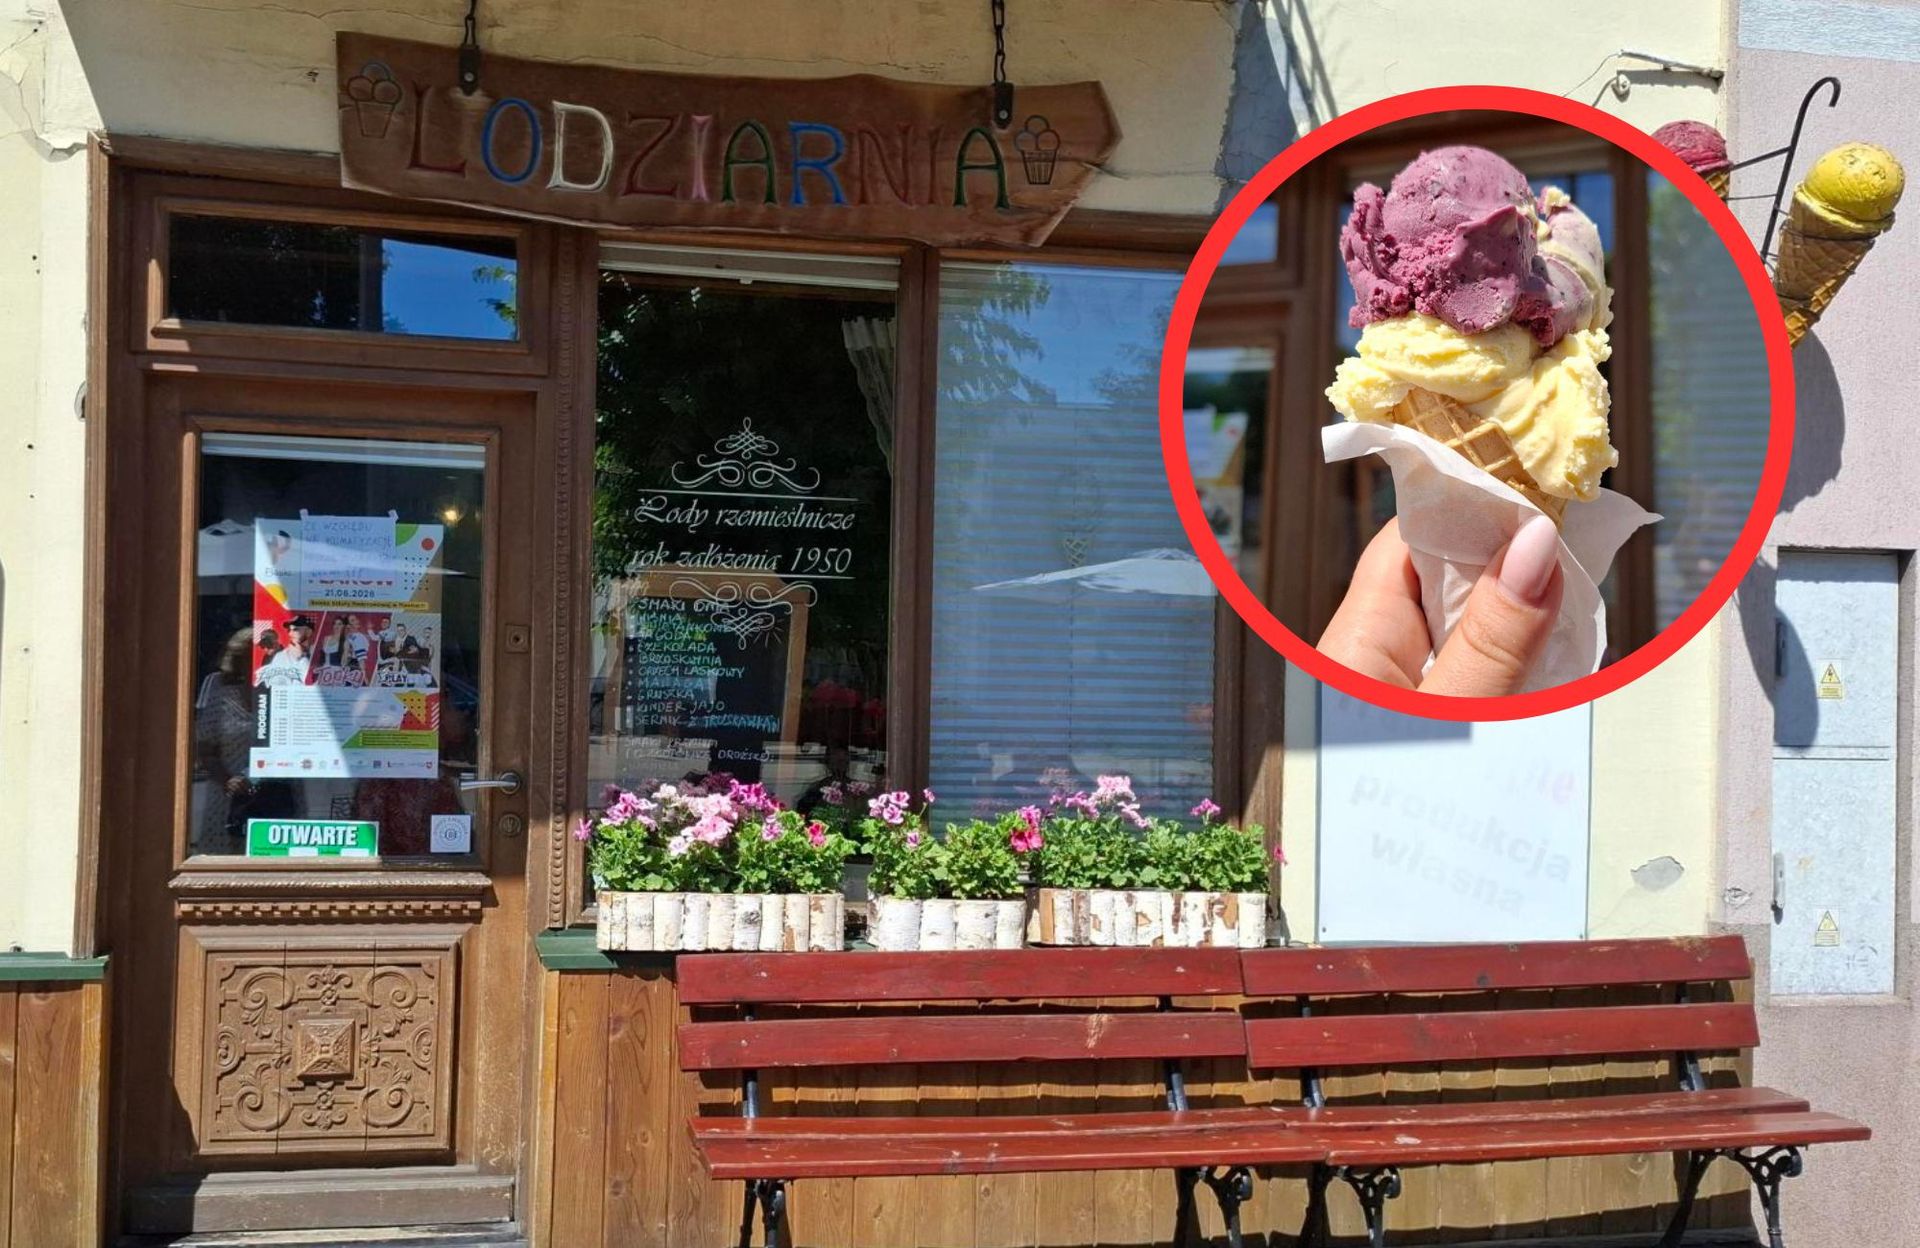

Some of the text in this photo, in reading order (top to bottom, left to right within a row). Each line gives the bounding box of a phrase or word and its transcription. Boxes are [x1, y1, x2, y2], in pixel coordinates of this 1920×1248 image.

[407, 83, 1012, 210] LODZIARNIA
[715, 502, 856, 531] rzemieślnicze
[630, 541, 853, 574] rok założenia 1950
[257, 694, 268, 739] PROGRAM
[690, 700, 725, 715] JAJO
[267, 824, 358, 846] OTWARTE
[1347, 772, 1572, 884] produkcja
